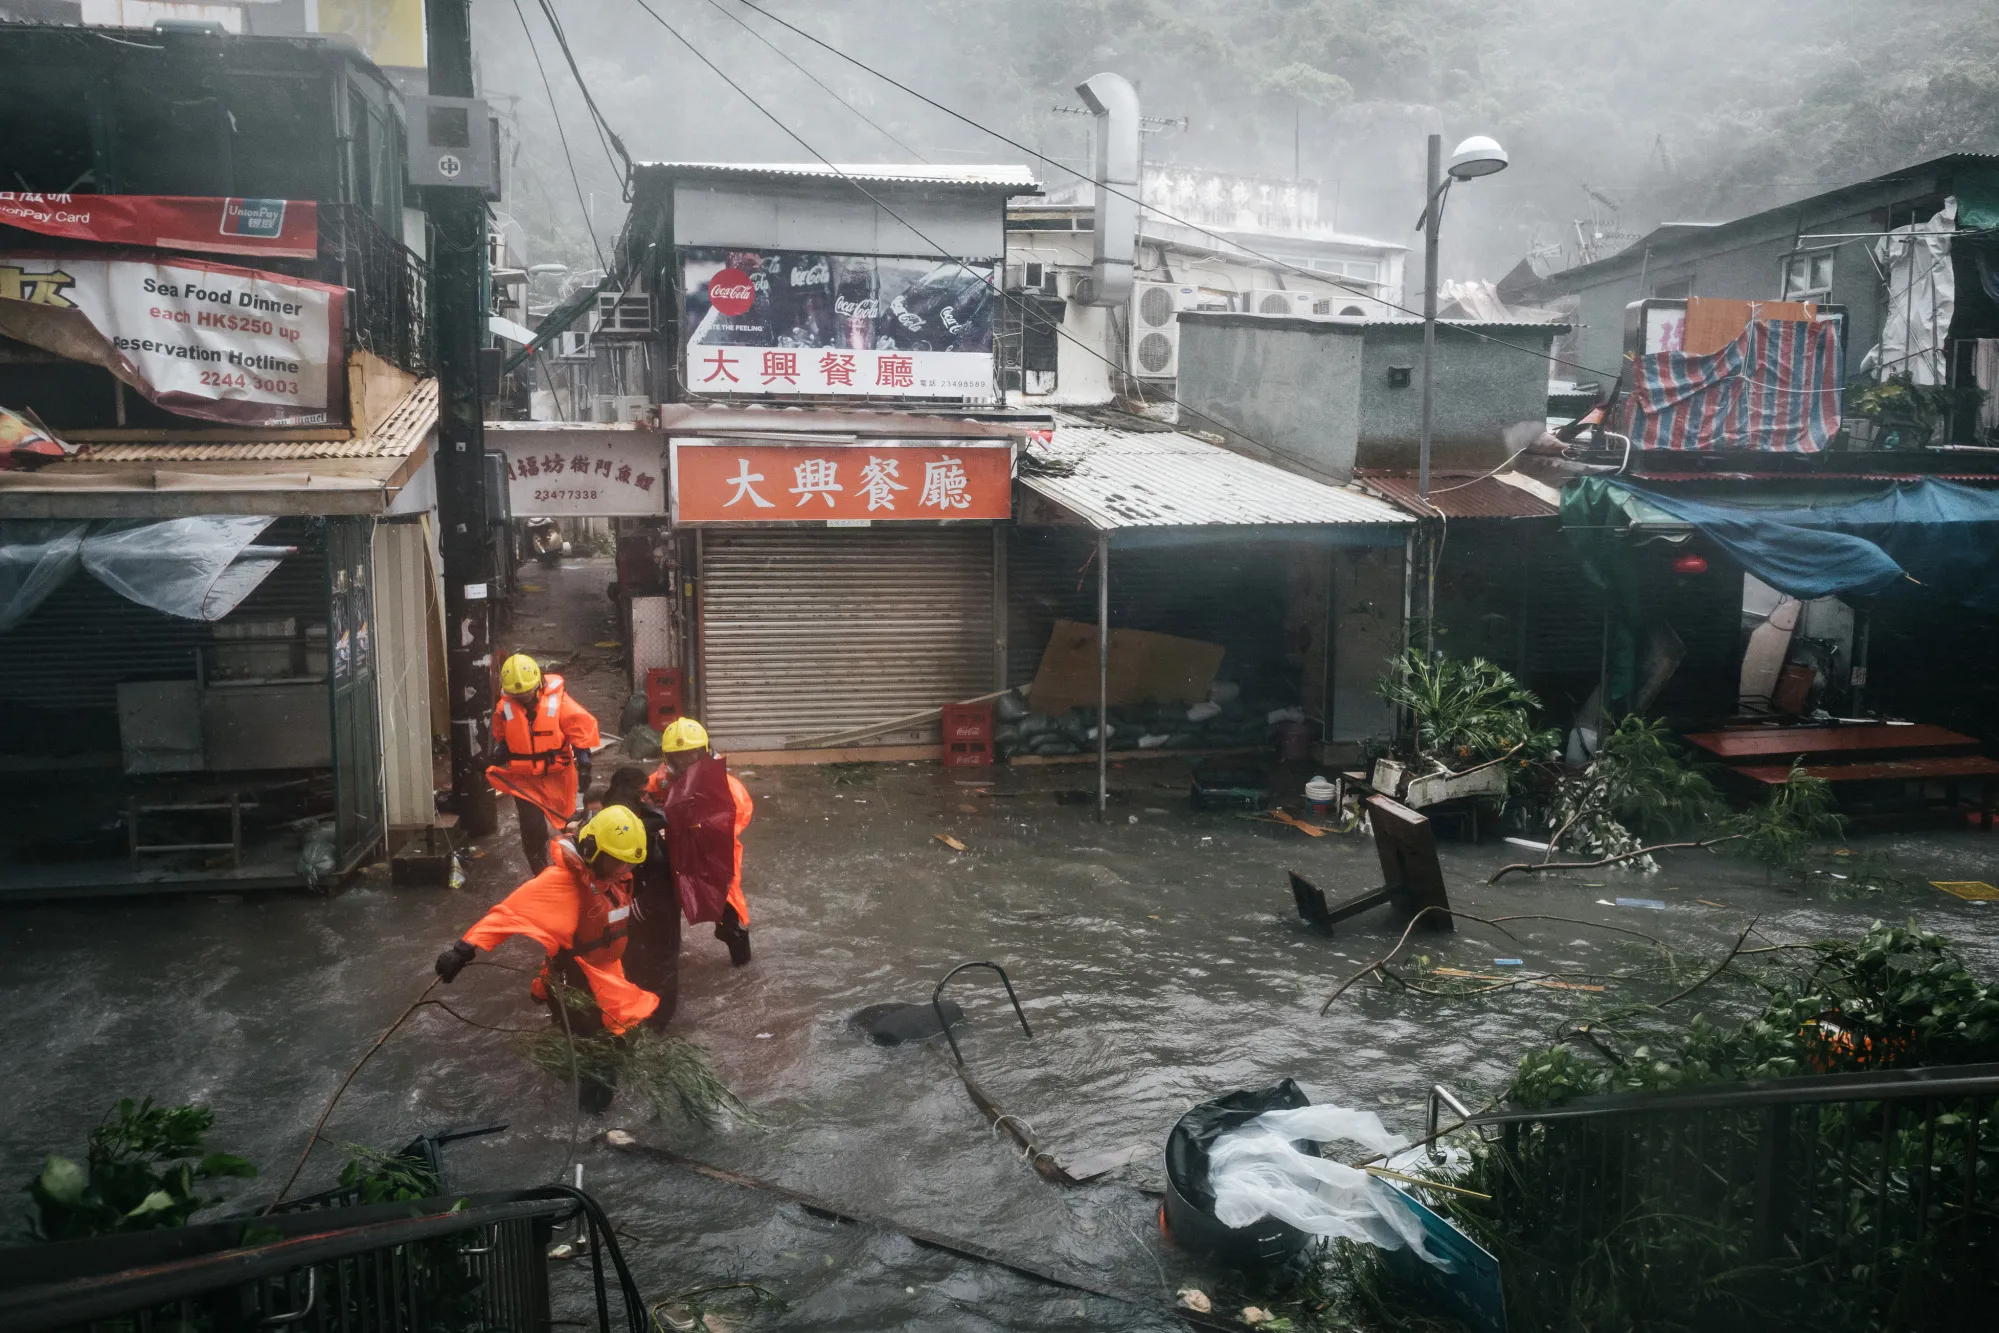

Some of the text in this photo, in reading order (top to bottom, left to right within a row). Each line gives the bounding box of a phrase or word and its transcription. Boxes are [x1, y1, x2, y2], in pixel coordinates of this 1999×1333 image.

[55, 211, 90, 223] Card
[229, 205, 279, 221] UnionPay
[143, 278, 303, 316] Sea Food Dinner
[710, 284, 753, 300] Coca-Cola
[150, 306, 300, 343] each HK$250 up
[113, 336, 299, 374] Reservation Hotline
[703, 349, 914, 387] 大興餐廳
[200, 371, 299, 395] 2244 3003
[535, 490, 597, 500] 23477338
[723, 455, 972, 512] 大興餐廳
